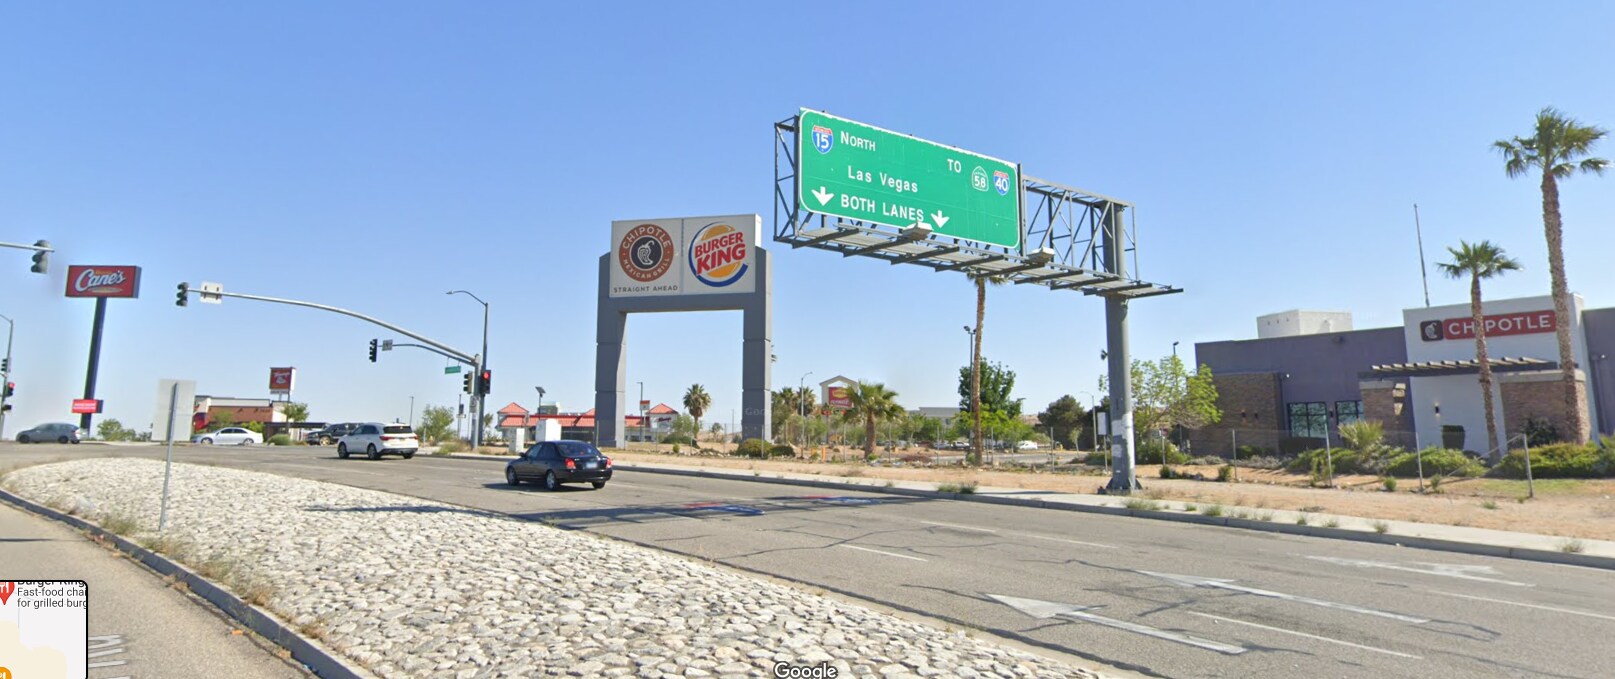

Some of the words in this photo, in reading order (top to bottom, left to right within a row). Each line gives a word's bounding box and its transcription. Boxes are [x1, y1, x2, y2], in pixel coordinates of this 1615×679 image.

[816, 132, 829, 149] 15
[840, 130, 876, 151] NORTH
[848, 165, 872, 182] Las
[880, 172, 918, 192] Vegas
[947, 158, 962, 173] TO
[974, 176, 986, 188] 58
[996, 177, 1008, 192] 40
[841, 194, 876, 213] BOTH
[882, 202, 924, 222] LANES
[622, 226, 672, 248] CHIPOTLE
[694, 232, 744, 258] BURGER
[623, 260, 652, 278] MEXICAN
[652, 258, 670, 276] GRILL
[696, 243, 746, 274] KING
[75, 268, 126, 292] Cane's
[1448, 314, 1551, 335] CHPOTLE
